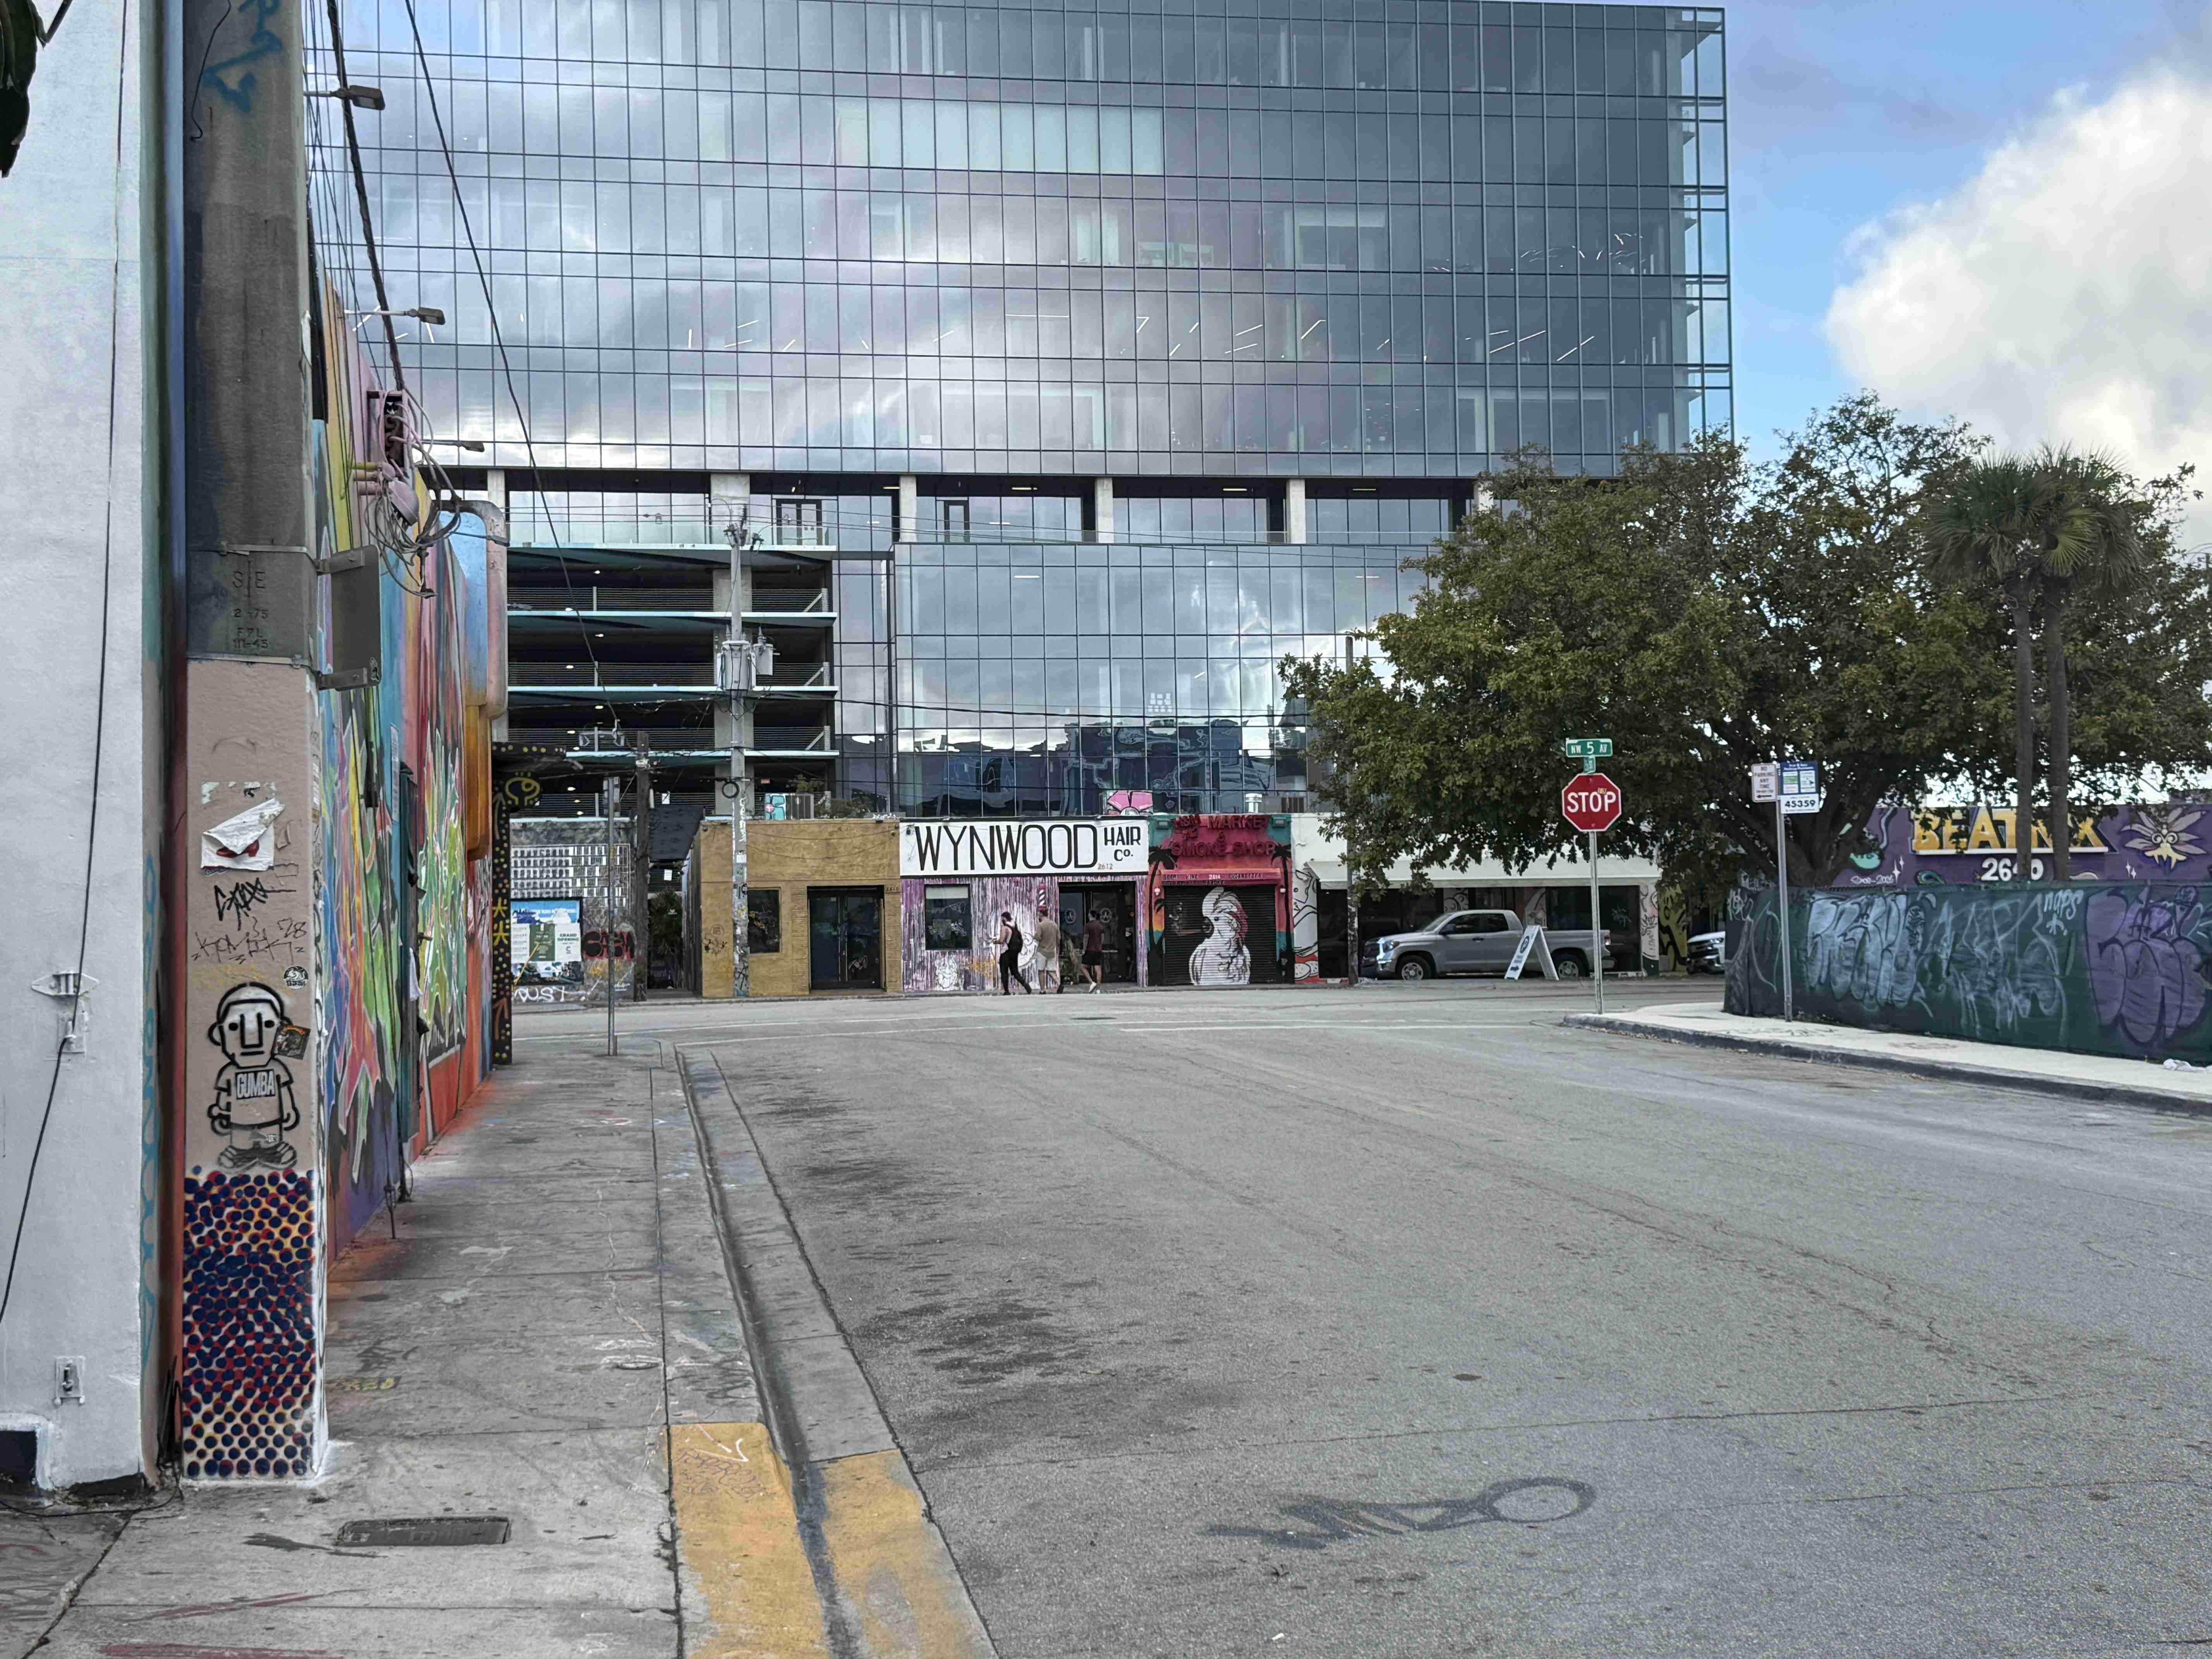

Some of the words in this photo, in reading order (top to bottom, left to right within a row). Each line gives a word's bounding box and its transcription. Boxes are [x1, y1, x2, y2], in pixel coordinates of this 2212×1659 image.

[1571, 745, 1582, 754] NW
[1587, 742, 1594, 754] 5
[1599, 744, 1607, 753] AV
[1567, 791, 1616, 813] STOP
[1785, 800, 1816, 808] 45359
[1207, 815, 1270, 830] MARKET
[914, 824, 1098, 871] WYNWOOD
[1104, 826, 1141, 846] HAIR
[1171, 842, 1228, 857] SMOKE
[1233, 841, 1277, 857] SHOP
[1981, 858, 2044, 882] 260
[237, 1070, 275, 1098] GUMBA
